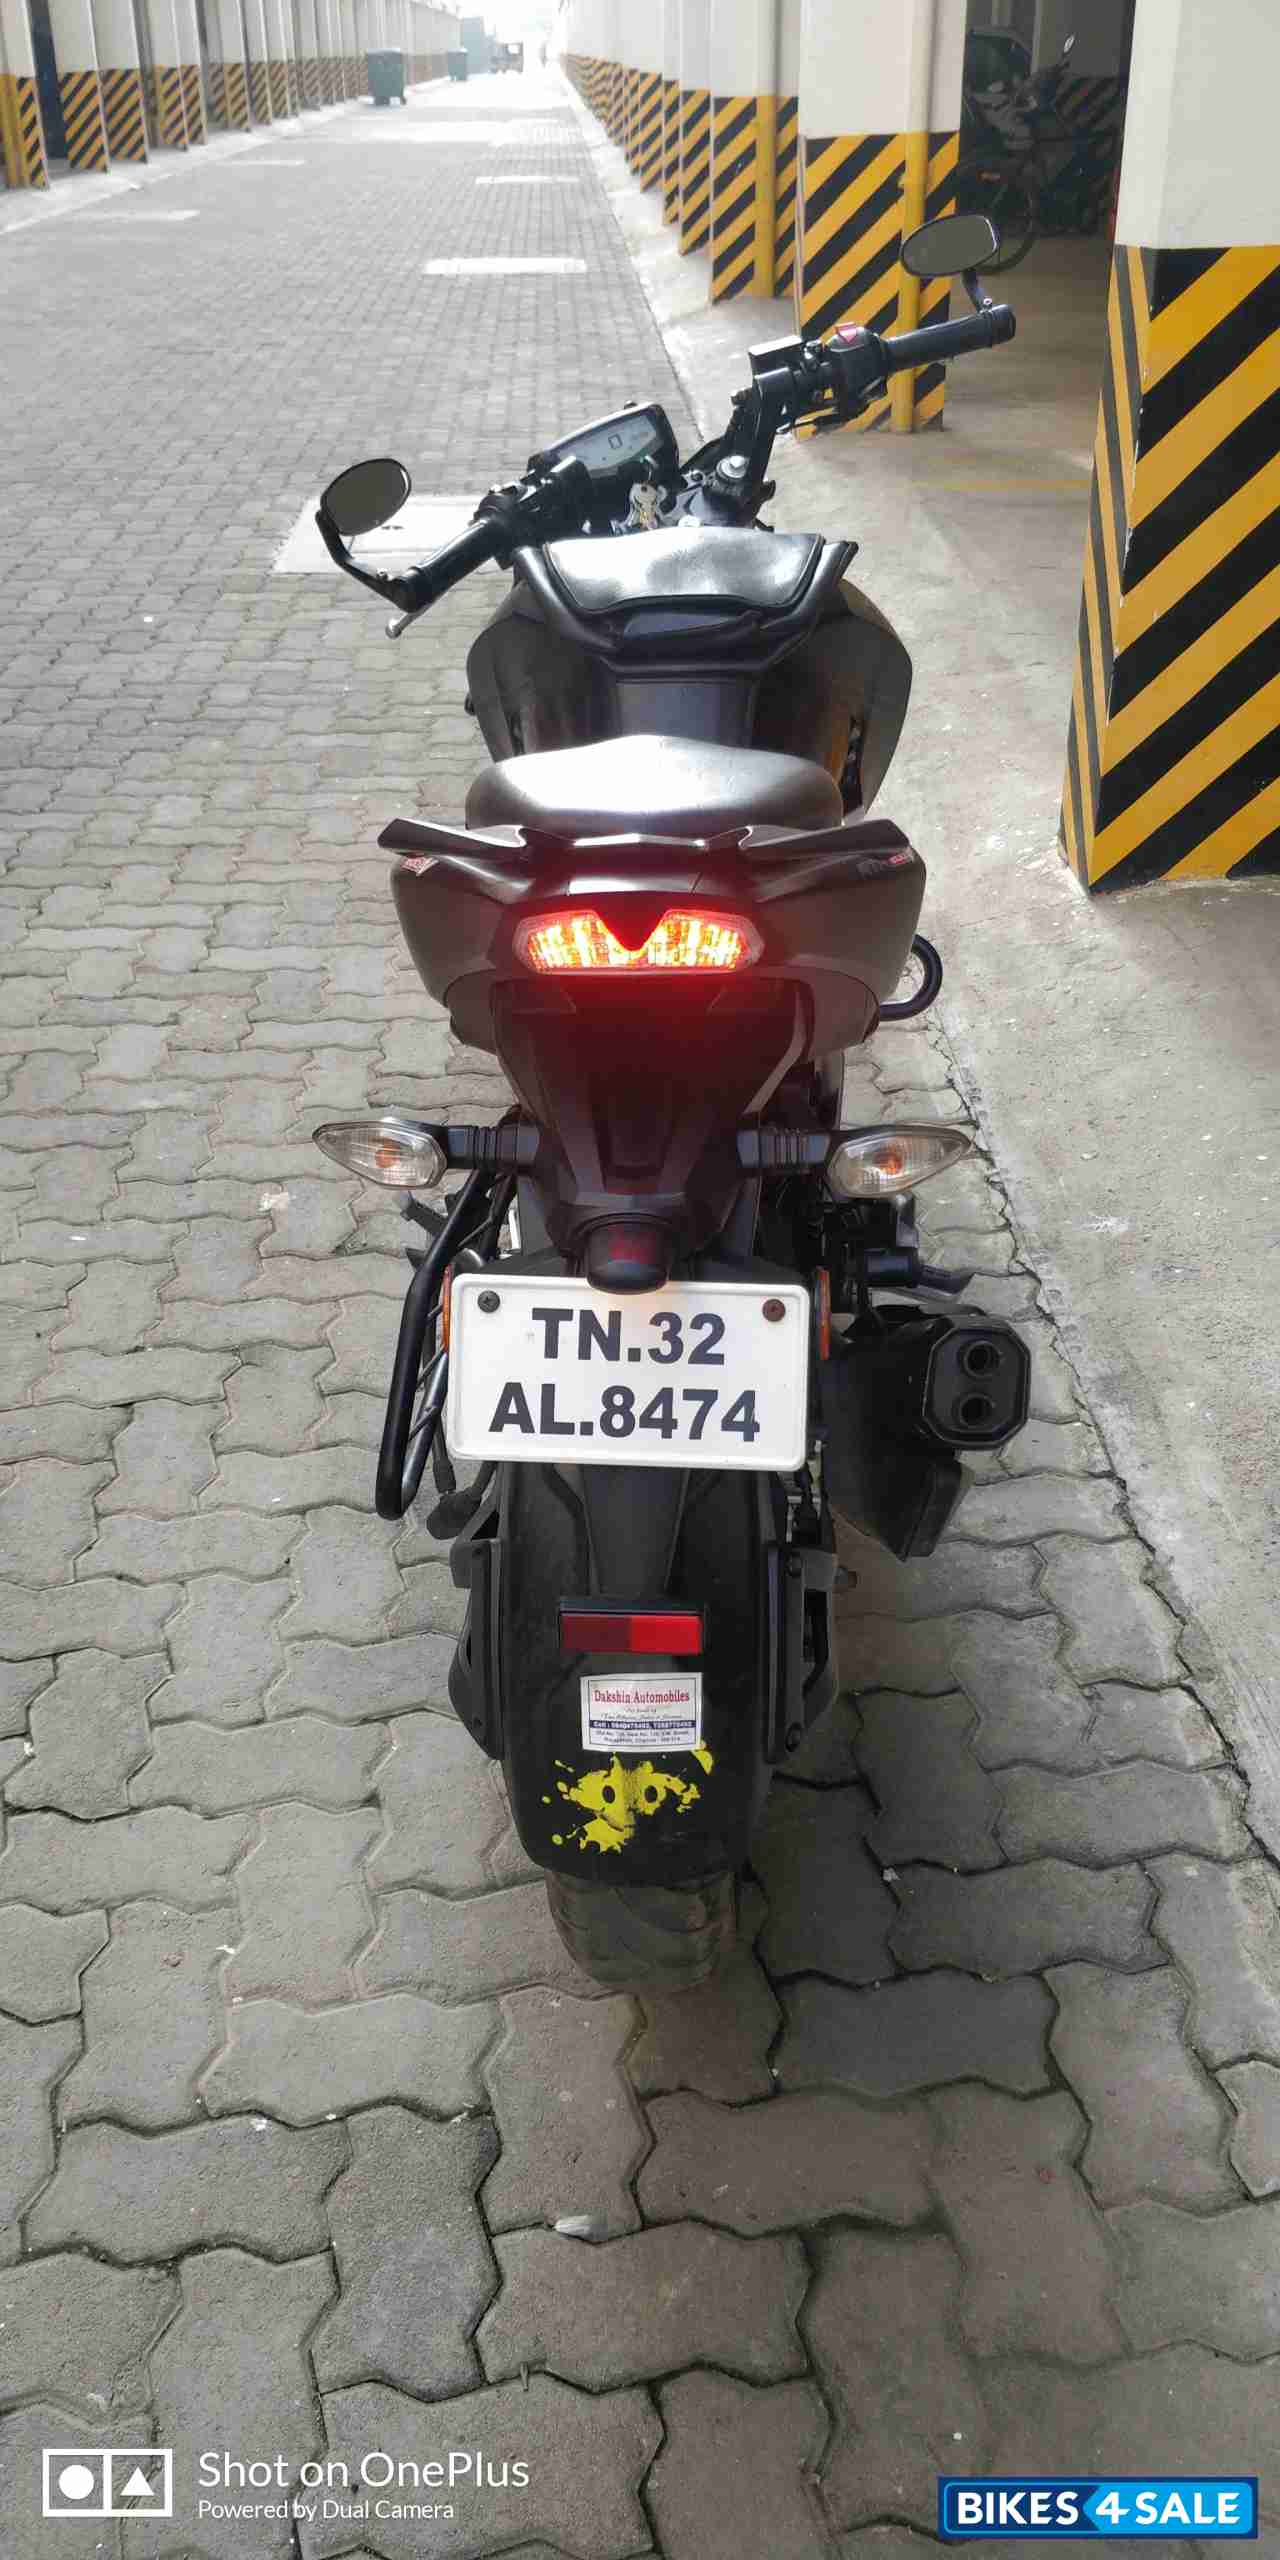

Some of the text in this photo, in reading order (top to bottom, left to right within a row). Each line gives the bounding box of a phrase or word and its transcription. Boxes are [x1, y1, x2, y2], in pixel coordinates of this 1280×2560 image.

[532, 1308, 725, 1365] TN.32
[488, 1382, 760, 1442] AL.8474
[594, 1689, 690, 1704] Dakshin Automobiles
